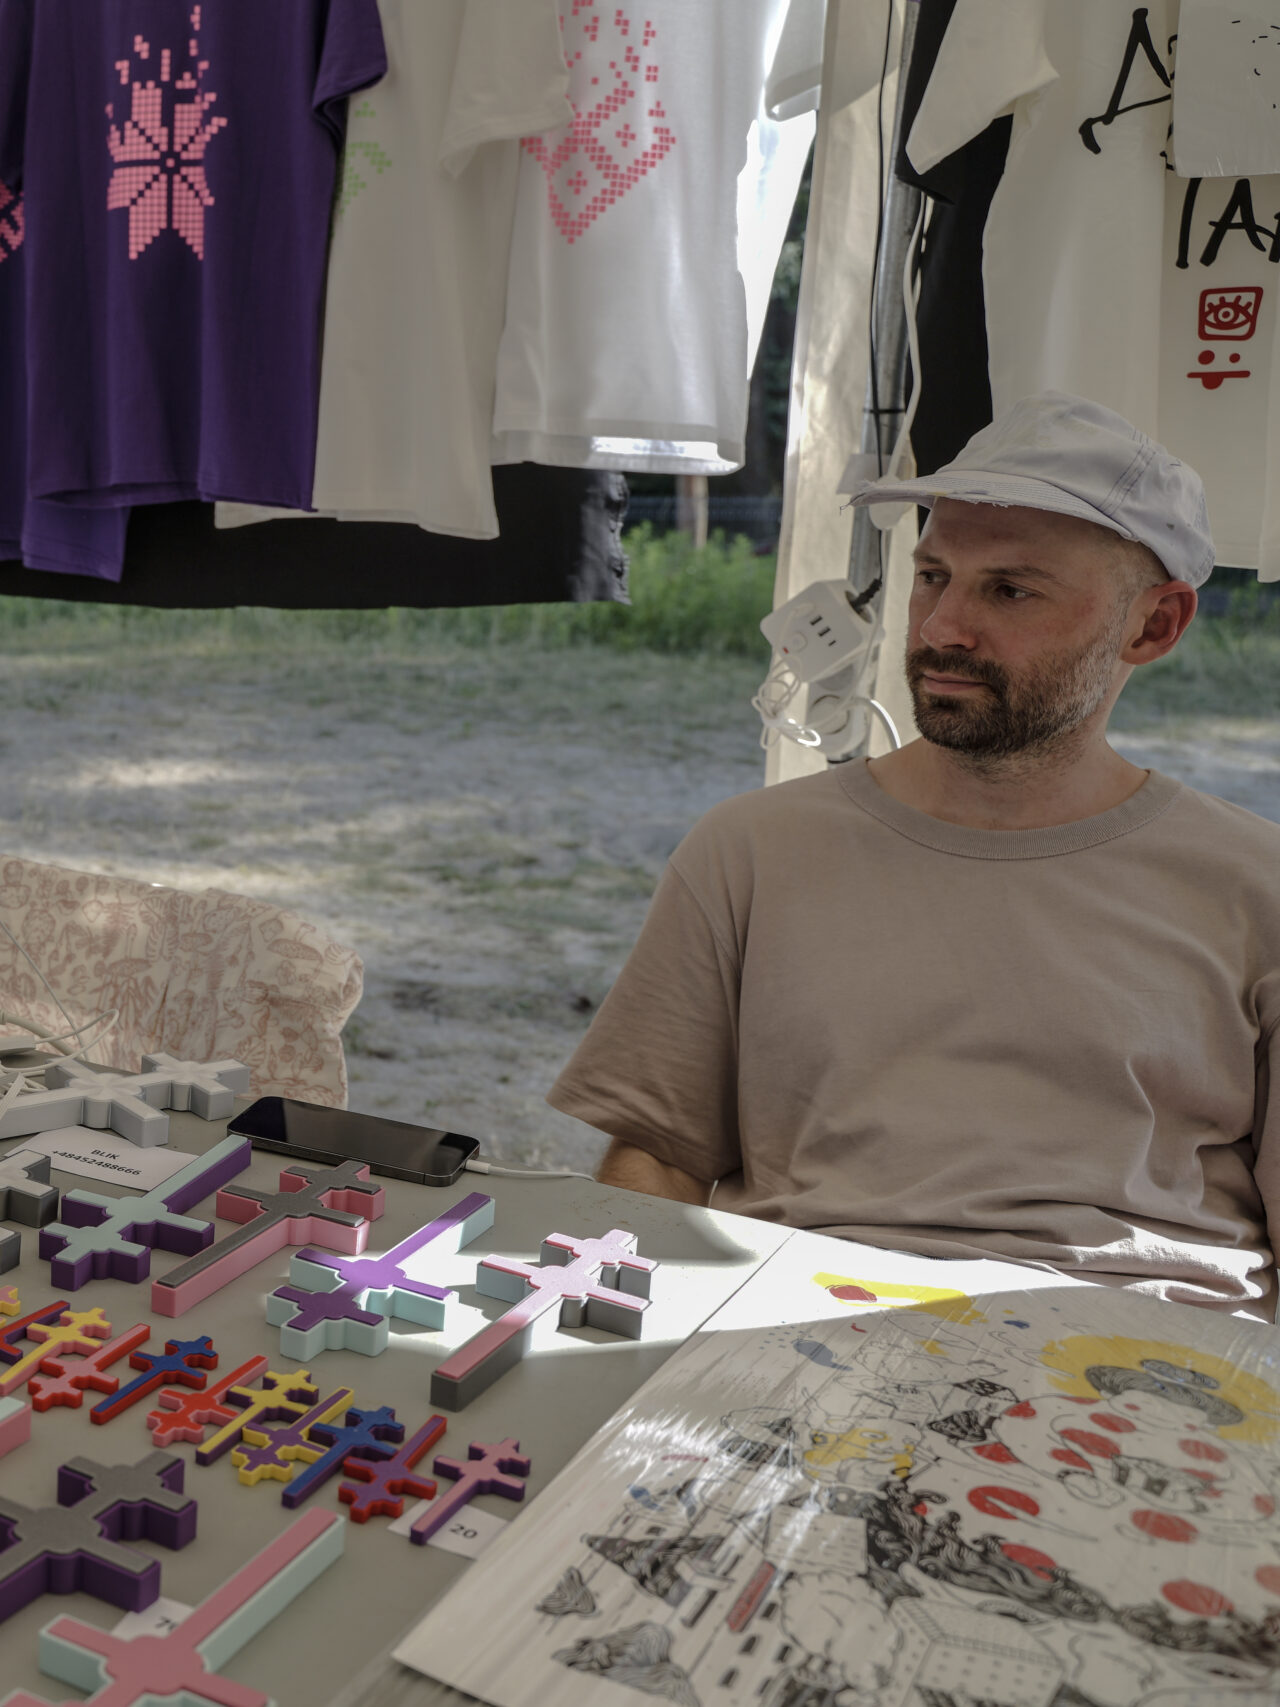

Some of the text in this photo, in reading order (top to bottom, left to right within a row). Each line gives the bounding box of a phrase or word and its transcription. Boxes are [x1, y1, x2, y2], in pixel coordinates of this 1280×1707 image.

[52, 1150, 142, 1176] +48452488666
[90, 1149, 120, 1160] BLIK
[450, 1523, 478, 1540] 20
